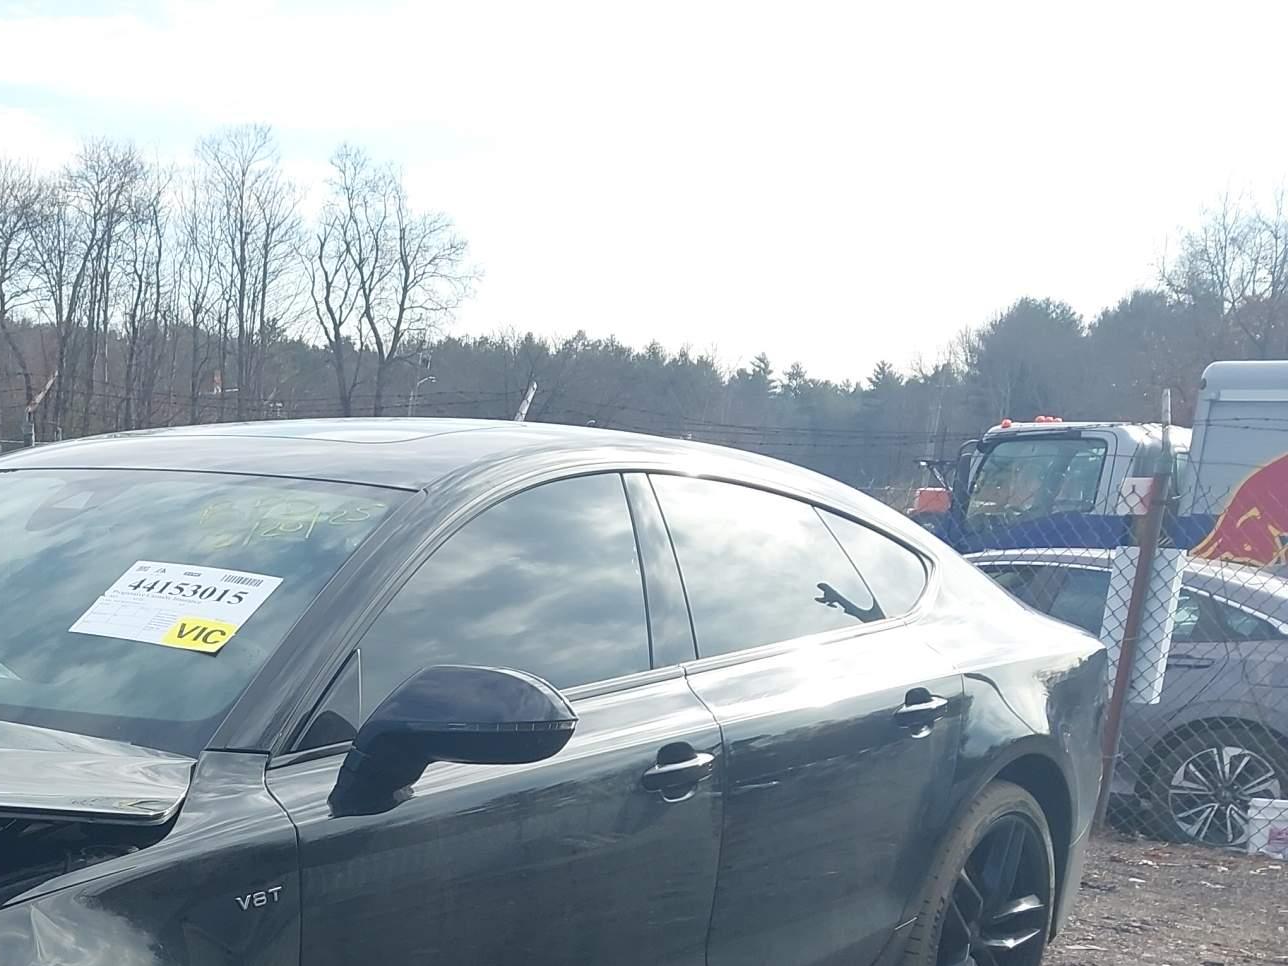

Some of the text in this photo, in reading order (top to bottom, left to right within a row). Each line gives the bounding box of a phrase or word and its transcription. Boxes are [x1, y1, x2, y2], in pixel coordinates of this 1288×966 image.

[127, 578, 249, 605] 44153015
[177, 622, 227, 645] VIC
[235, 886, 283, 911] V8T
